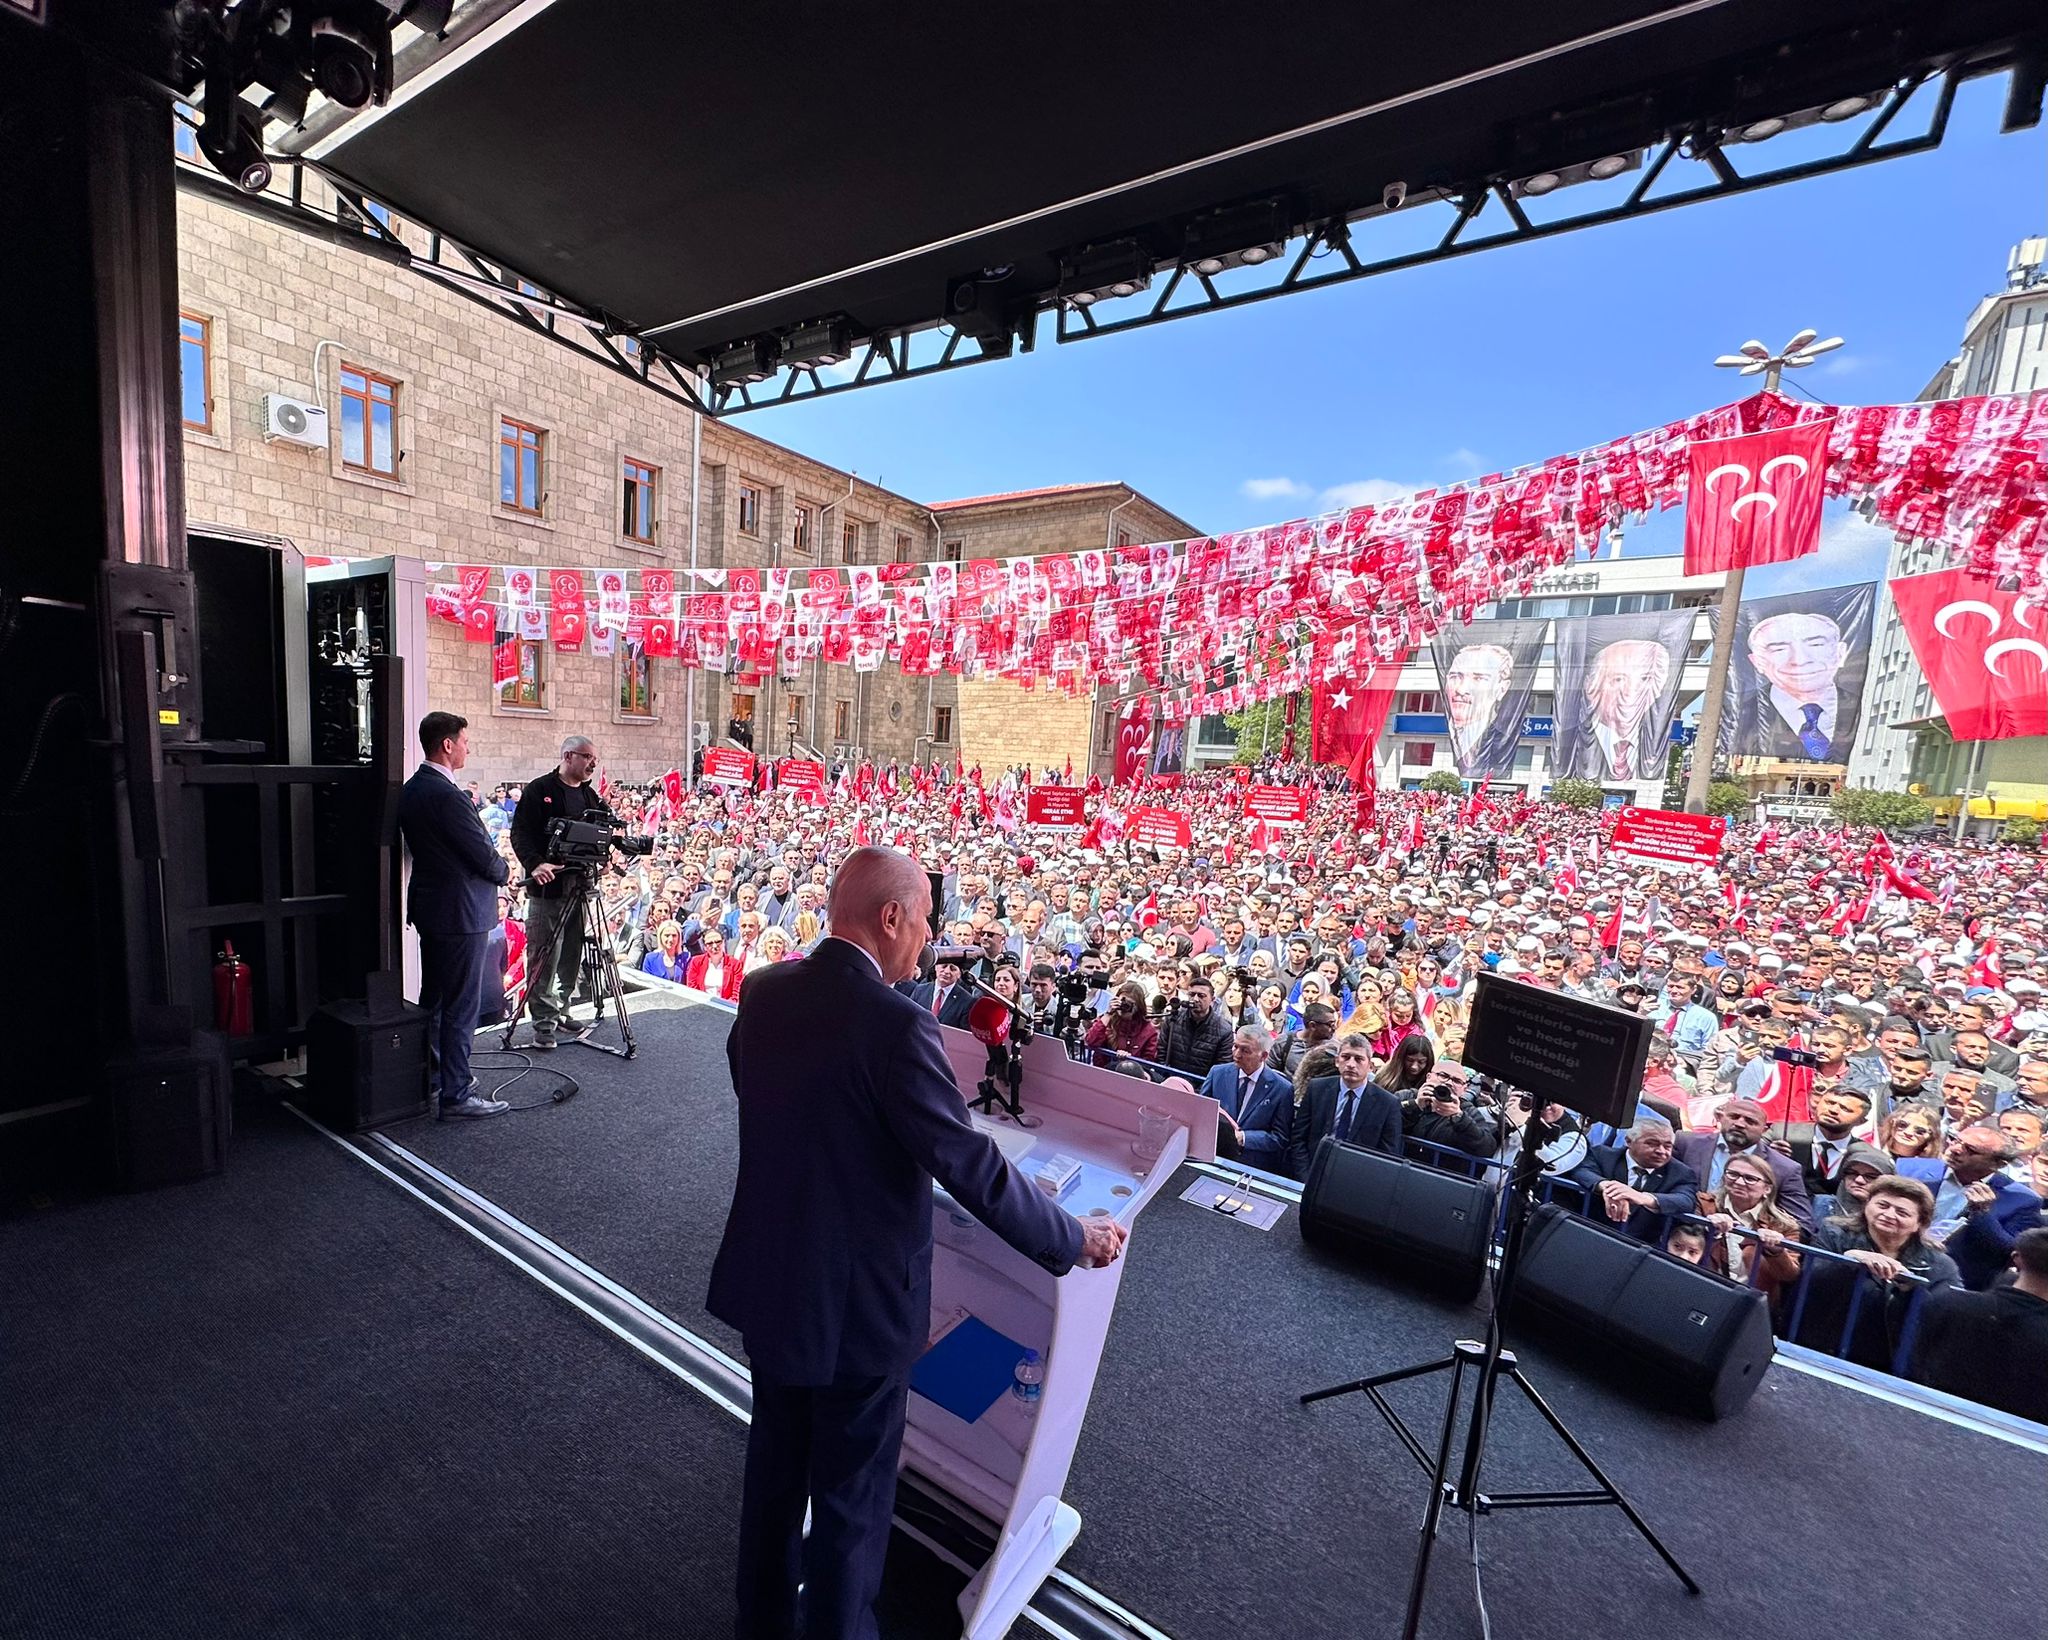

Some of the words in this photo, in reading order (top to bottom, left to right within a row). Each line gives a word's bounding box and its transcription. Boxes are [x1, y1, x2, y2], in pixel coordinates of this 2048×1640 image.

[1534, 723, 1554, 731] BA
[1516, 1024, 1534, 1036] ve
[1536, 1029, 1578, 1050] hedef
